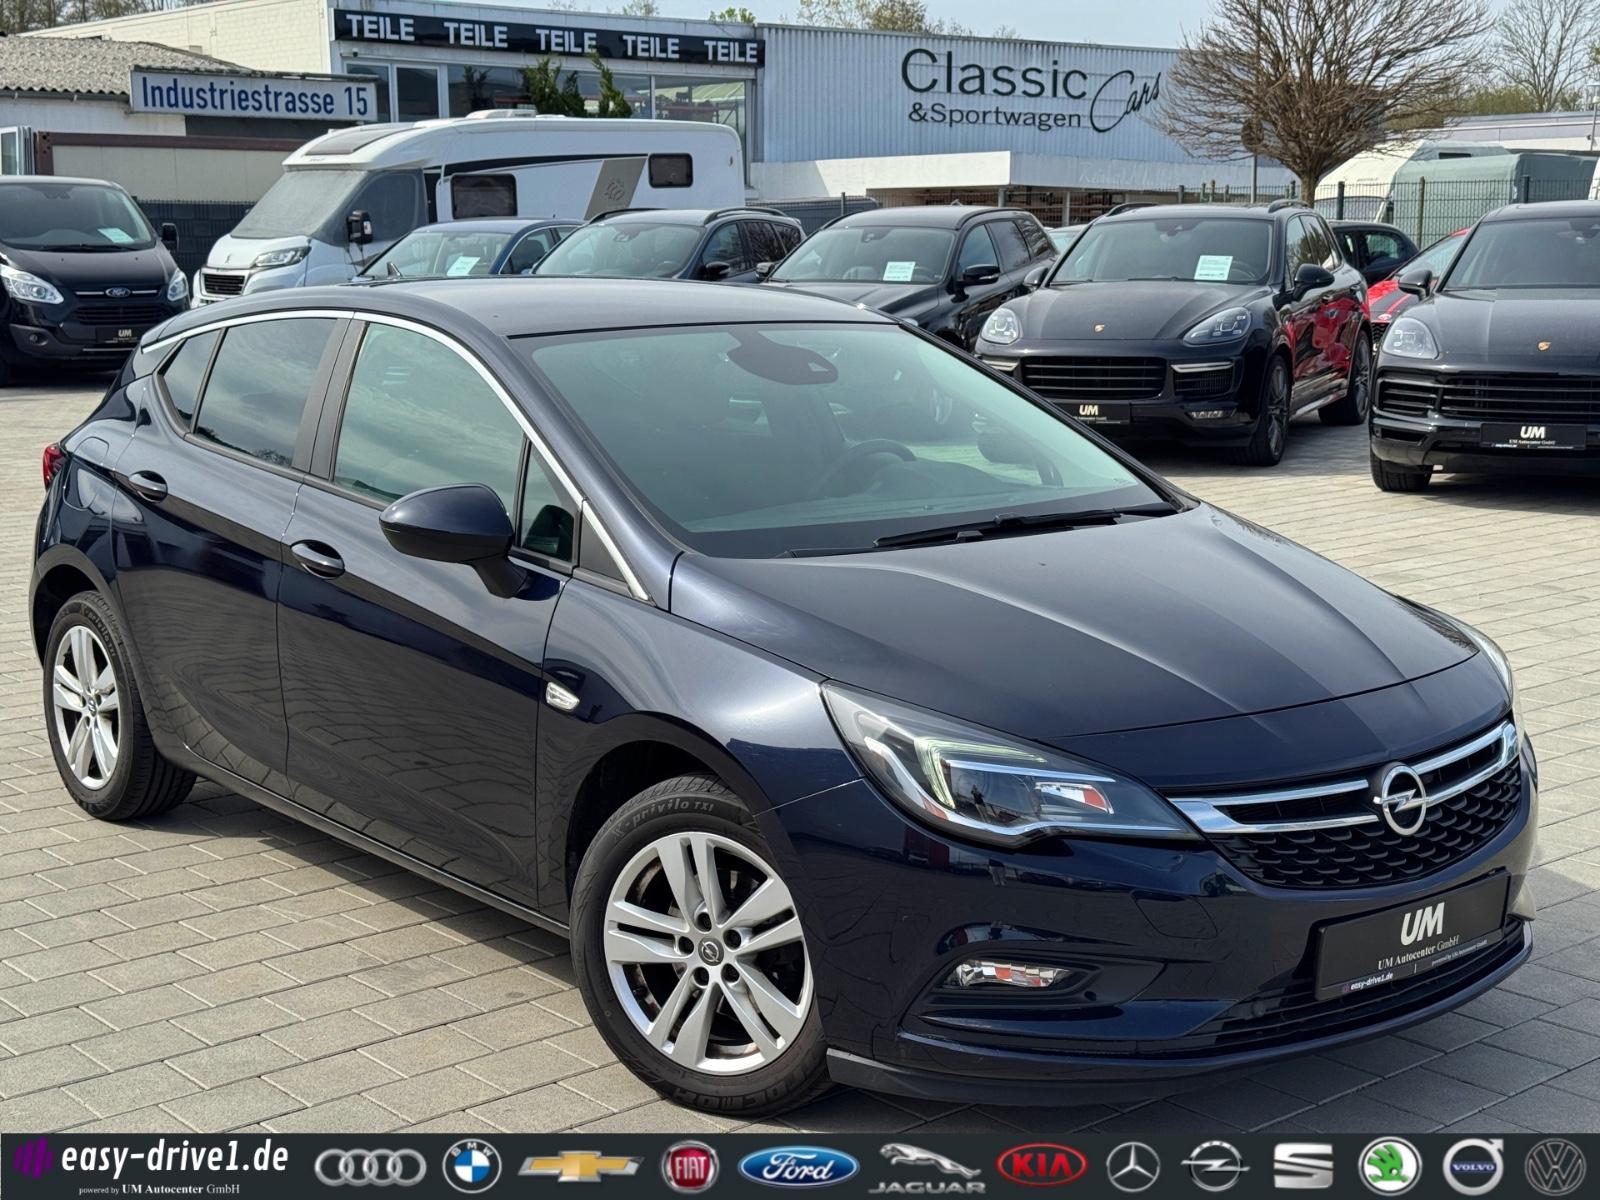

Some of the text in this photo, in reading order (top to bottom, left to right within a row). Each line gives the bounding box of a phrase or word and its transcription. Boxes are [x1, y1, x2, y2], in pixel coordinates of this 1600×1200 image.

[346, 14, 758, 63] TEILE TEILE TEILE TEILE TEILE
[142, 76, 368, 116] Industriestrasse 15
[901, 48, 1162, 133] Classic Cars
[908, 101, 1082, 131] &Sportwagen
[118, 329, 132, 337] UM
[1079, 404, 1099, 416] UM
[1520, 426, 1546, 439] UM
[1400, 901, 1446, 947] UM
[1377, 957, 1394, 971] UM
[1395, 945, 1436, 966] Autocenter
